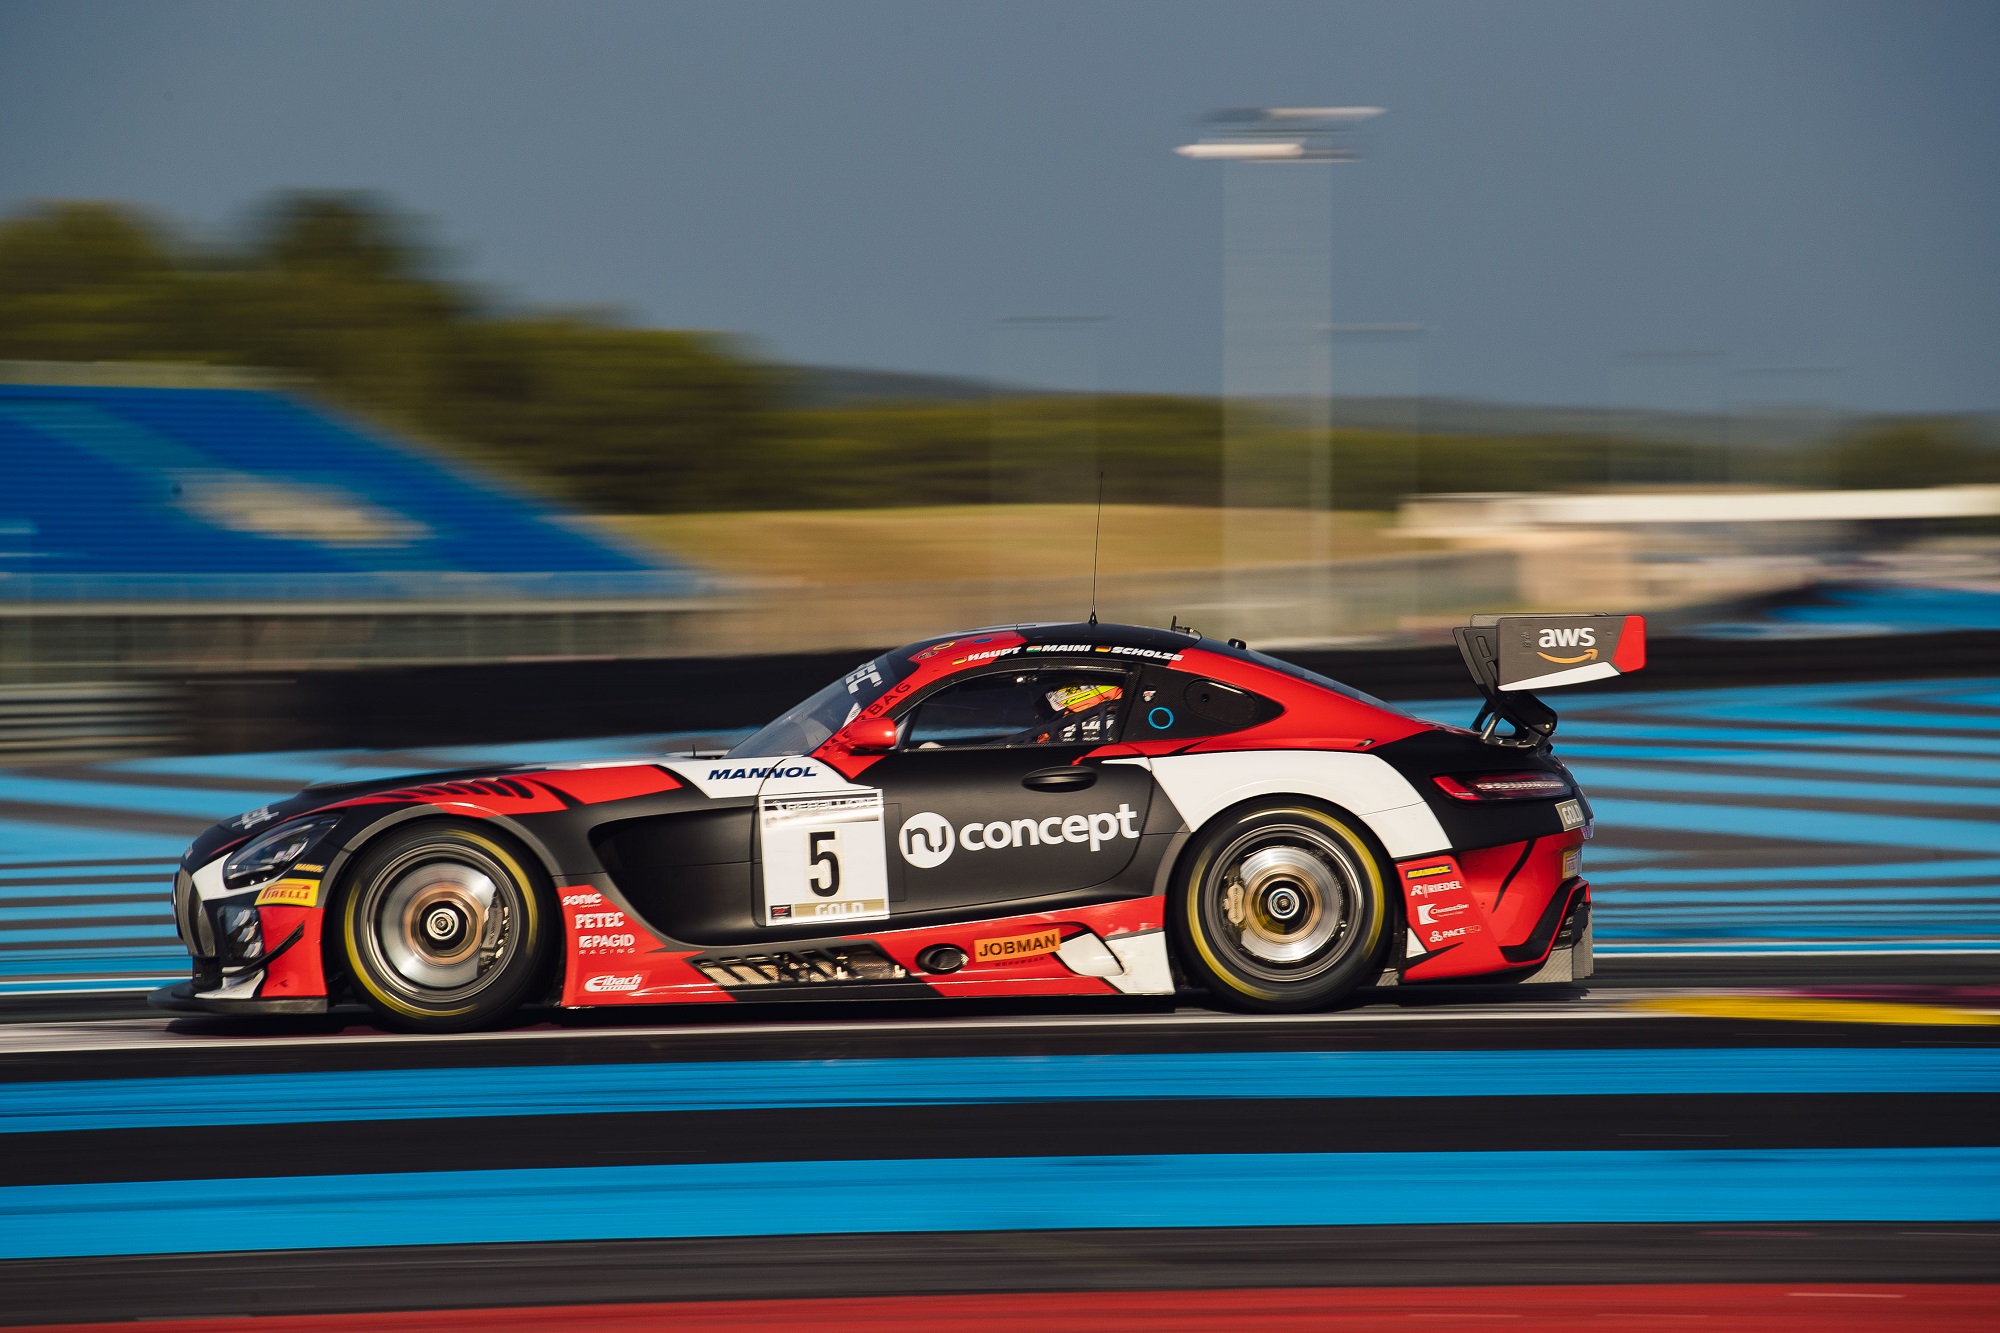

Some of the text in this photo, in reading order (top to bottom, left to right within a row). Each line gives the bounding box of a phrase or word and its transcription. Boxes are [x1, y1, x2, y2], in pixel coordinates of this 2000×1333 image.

[1538, 627, 1596, 648] aws
[967, 644, 1185, 661] HAUPT MAINI SCHOLZE
[707, 766, 818, 781] MANNOL
[1561, 804, 1583, 825] GOLD
[959, 803, 1140, 852] concept
[809, 830, 840, 898] 5
[261, 883, 312, 900] PIRELLI
[814, 902, 855, 918] GOLD
[575, 912, 625, 929] PETEC
[592, 934, 635, 948] PAGID
[979, 934, 1056, 957] JOBMAN
[584, 974, 643, 992] Eibach
